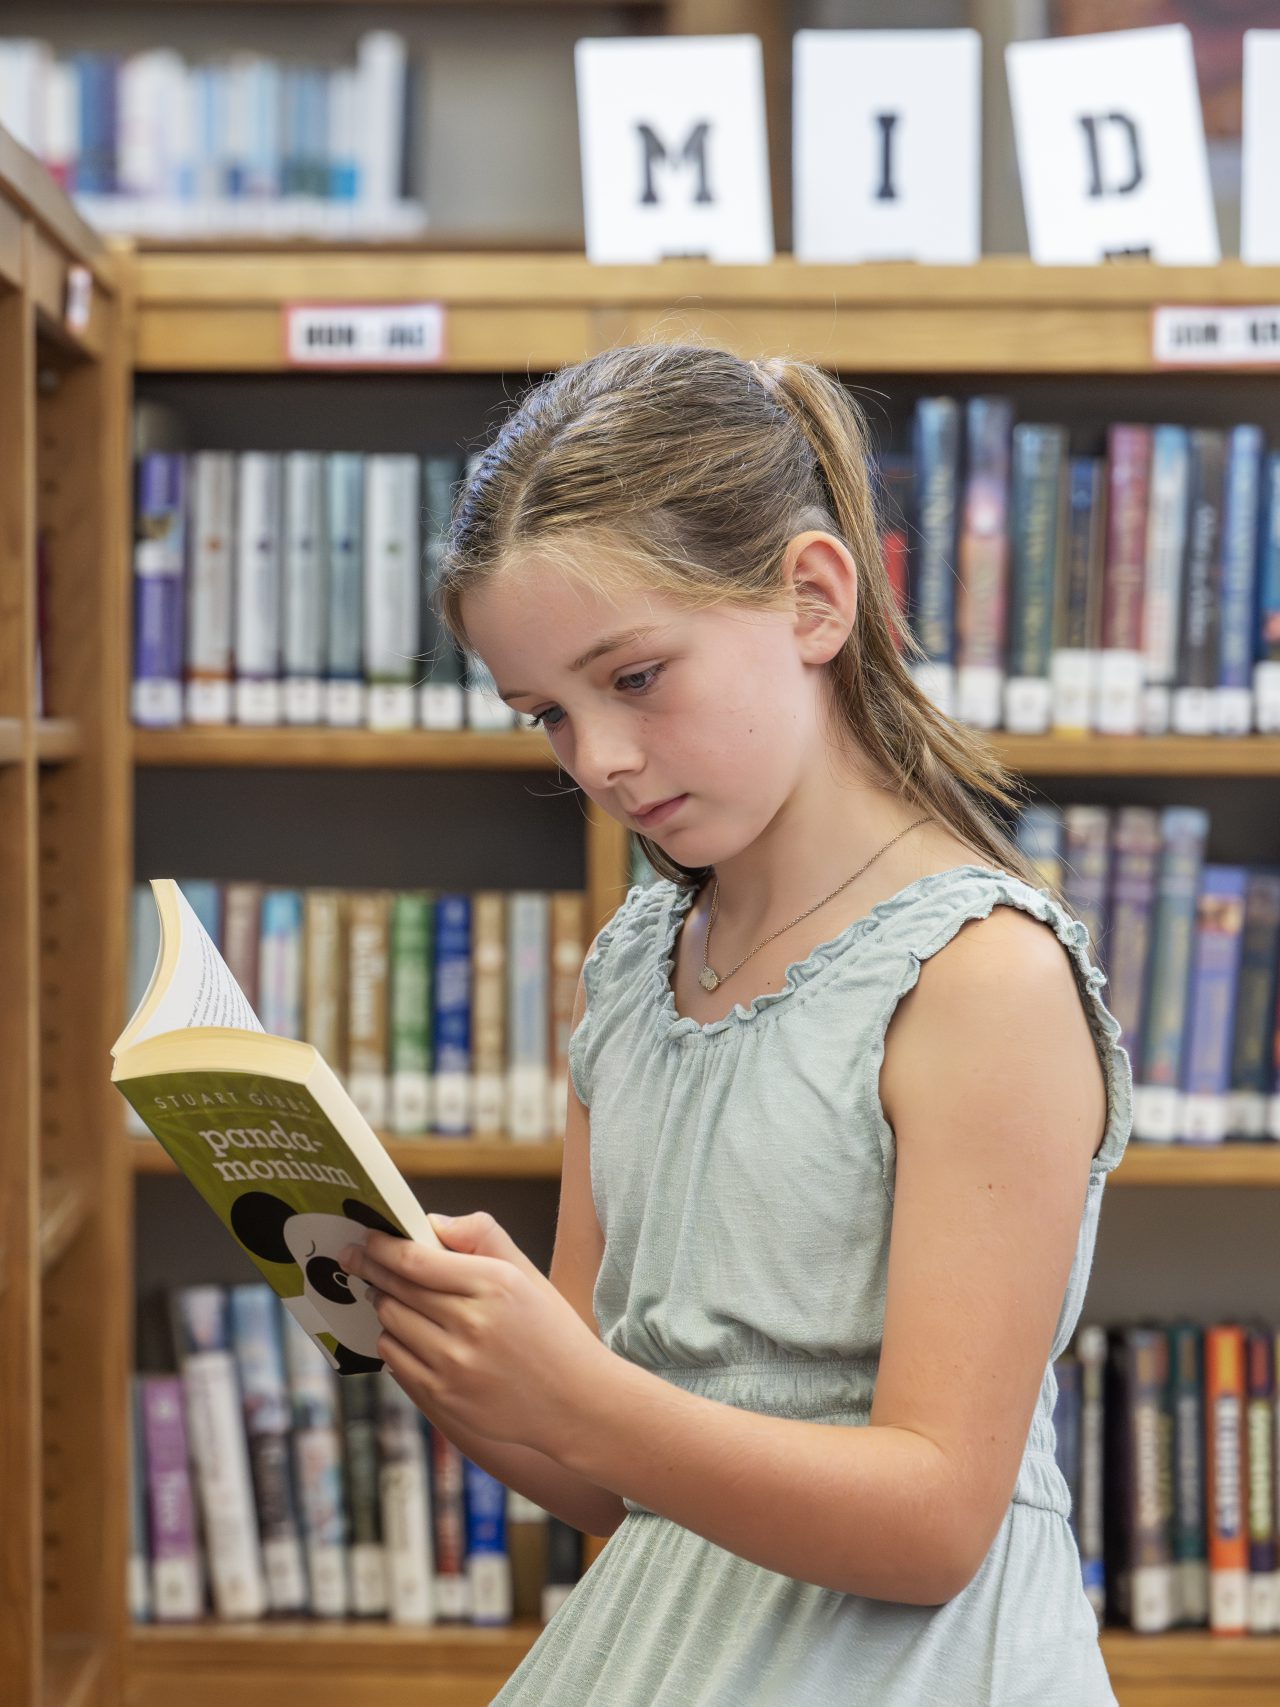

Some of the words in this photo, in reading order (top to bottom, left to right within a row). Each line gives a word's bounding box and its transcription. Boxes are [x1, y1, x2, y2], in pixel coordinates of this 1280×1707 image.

[637, 122, 713, 206] M
[875, 112, 899, 202] I
[1079, 113, 1143, 197] D
[153, 1092, 239, 1110] STUART
[198, 1120, 323, 1157] panda-
[212, 1153, 360, 1190] monium
